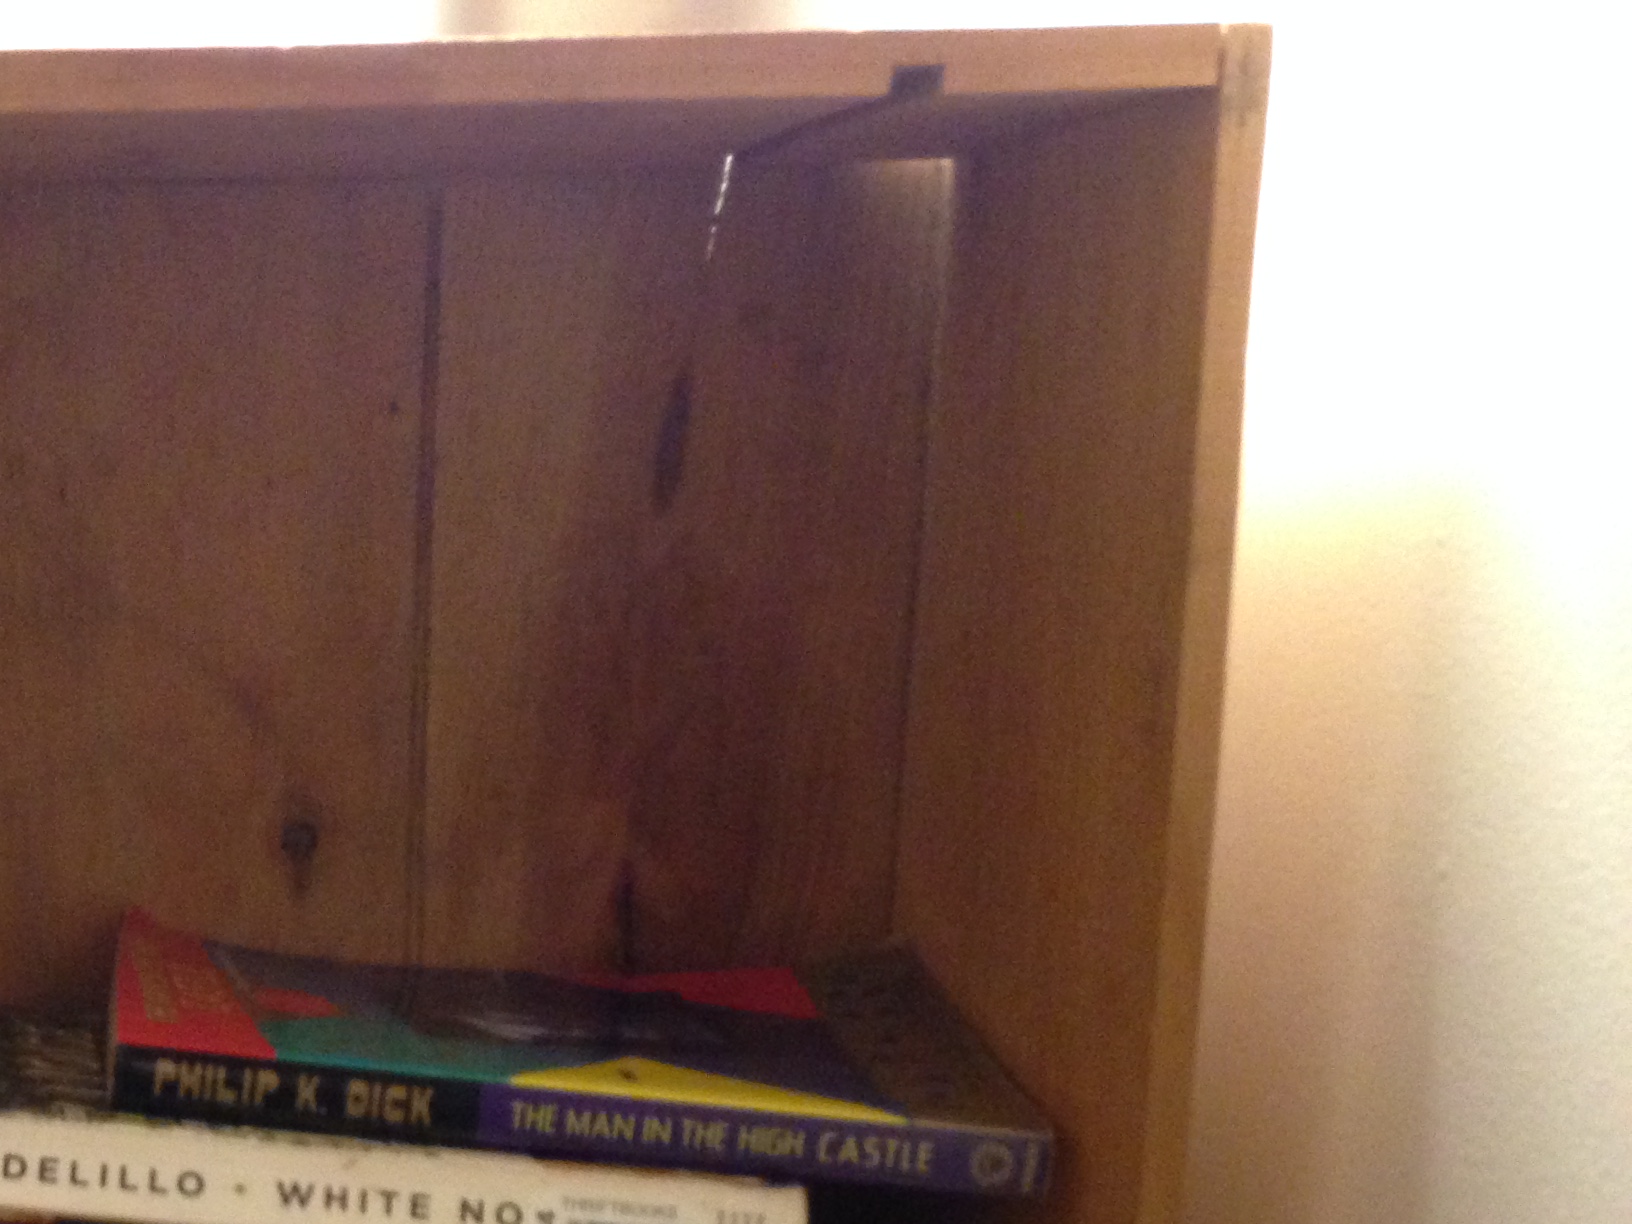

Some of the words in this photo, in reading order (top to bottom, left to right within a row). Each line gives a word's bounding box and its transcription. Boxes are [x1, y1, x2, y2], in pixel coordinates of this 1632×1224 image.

[152, 1056, 277, 1106] PHILIP
[345, 1078, 434, 1126] DICK
[510, 1098, 556, 1134] THE
[567, 1107, 634, 1143] MAN
[642, 1114, 673, 1145] IN
[681, 1119, 731, 1158] THE
[739, 1124, 805, 1160] HIGH
[817, 1126, 936, 1174] CASTLE
[2, 1152, 207, 1198] DELILLO
[277, 1179, 432, 1222] WHITE
